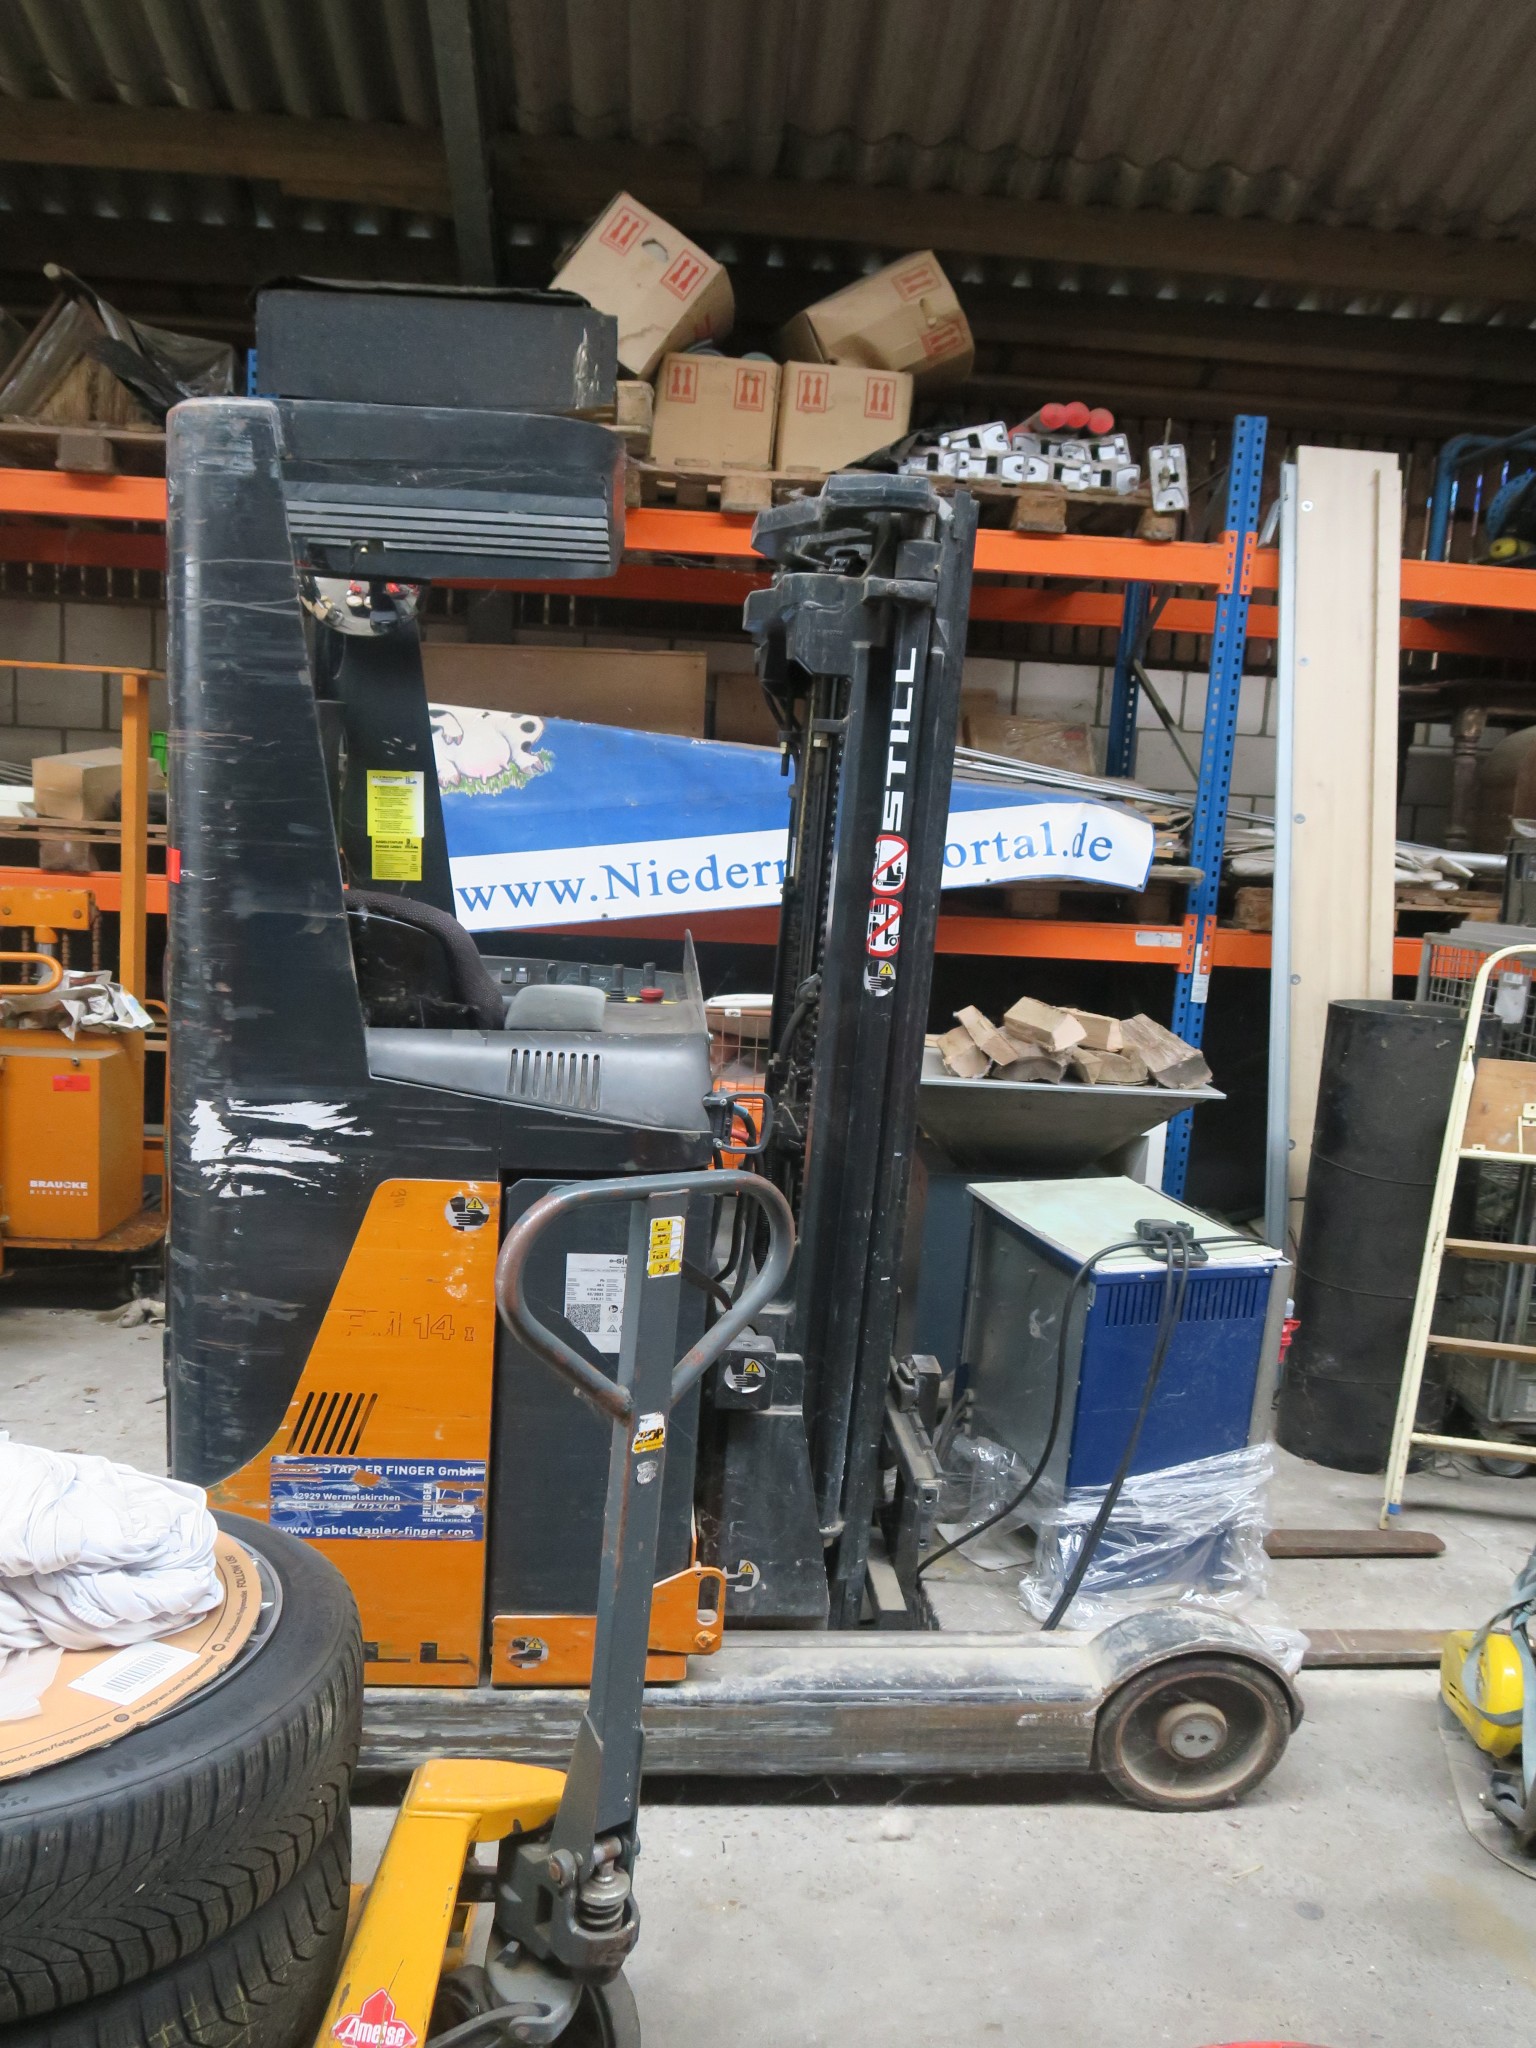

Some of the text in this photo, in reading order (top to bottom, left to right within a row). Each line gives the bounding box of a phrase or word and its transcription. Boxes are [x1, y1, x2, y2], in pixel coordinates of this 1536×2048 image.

[881, 647, 917, 832] STILL
[29, 1180, 88, 1189] BRAUCKE
[385, 1465, 435, 1477] FINGER
[438, 1466, 477, 1477] GmbH
[293, 1492, 401, 1502] 42929 Wermelskirchen
[279, 1525, 474, 1538] www.gabelstapler-fingercom
[337, 2017, 406, 2047] Ameise
